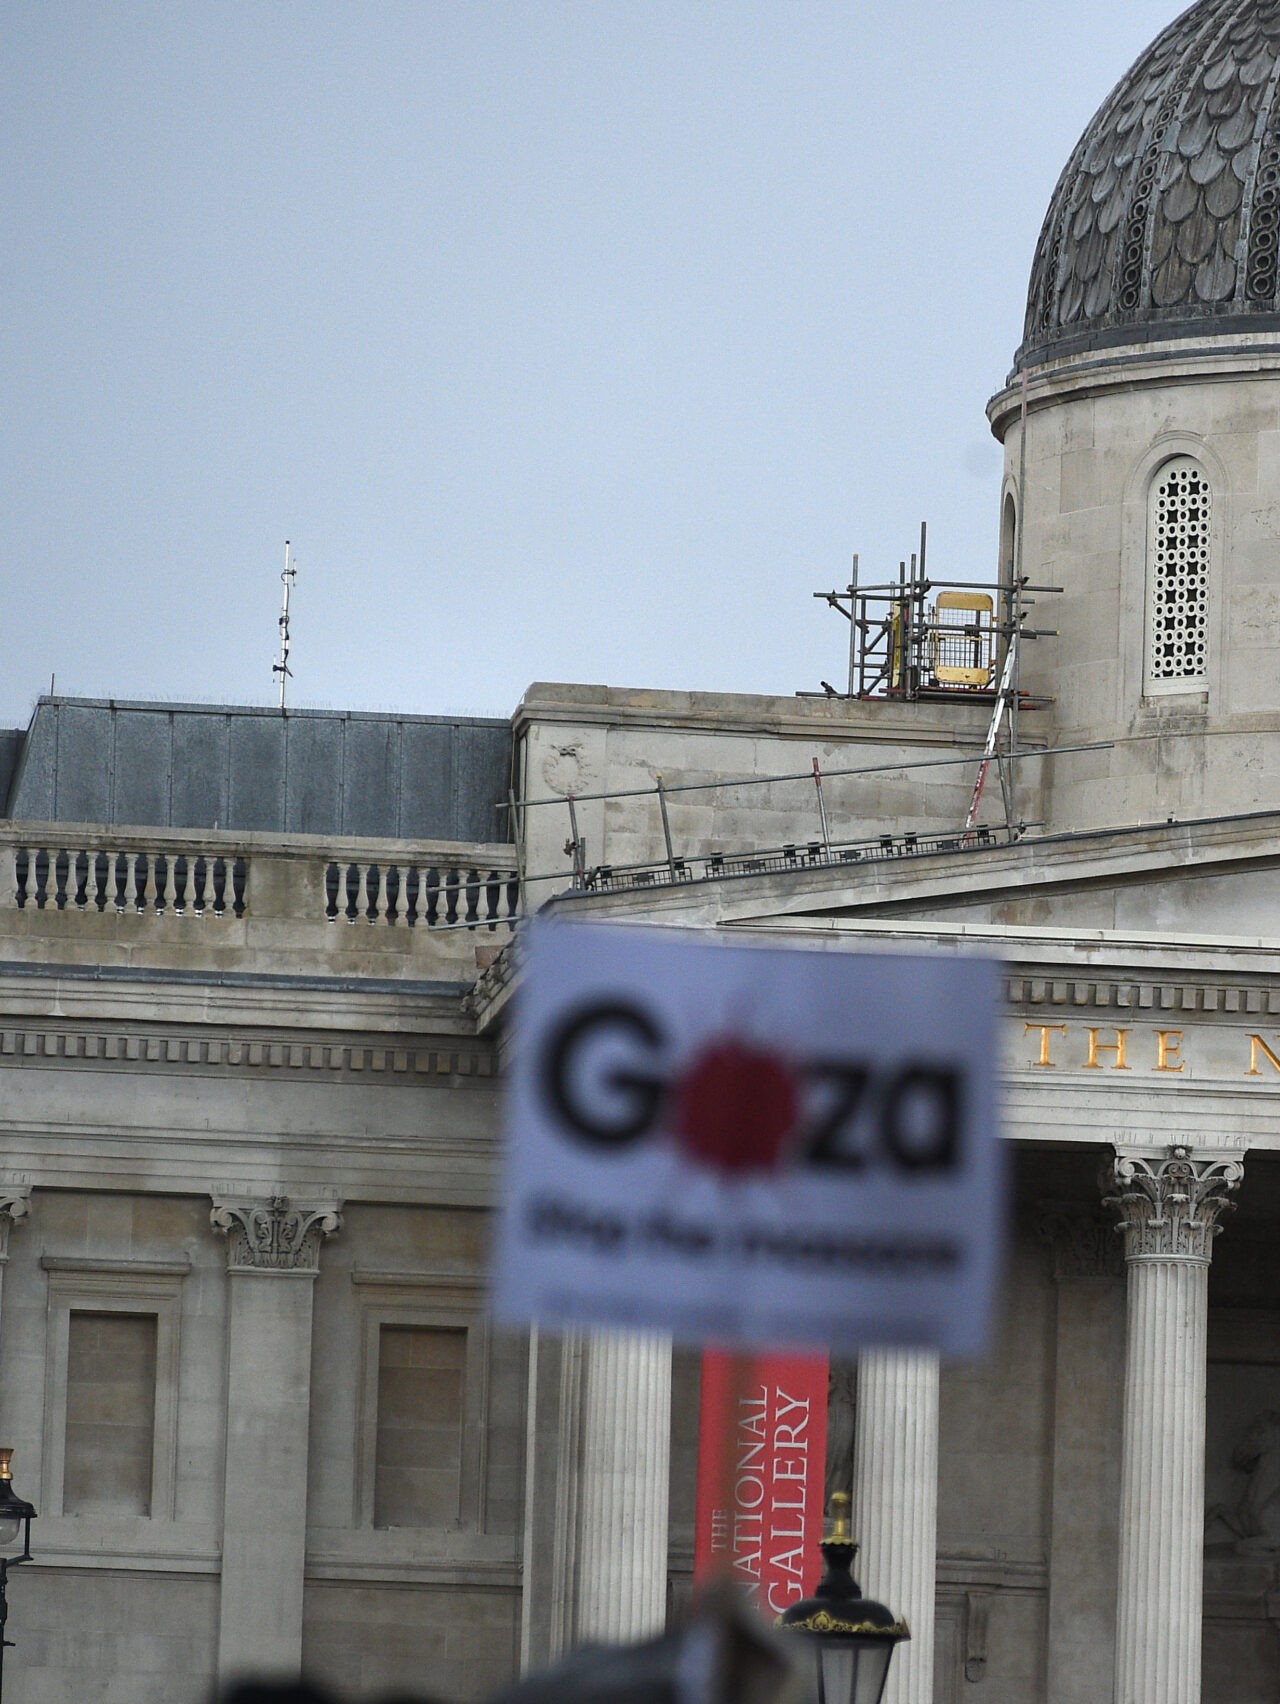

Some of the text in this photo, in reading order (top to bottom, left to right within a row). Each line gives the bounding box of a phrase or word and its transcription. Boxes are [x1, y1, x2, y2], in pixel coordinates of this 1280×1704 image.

[541, 996, 964, 1178] Gza
[1023, 1022, 1187, 1073] THE
[711, 1509, 729, 1553] THE
[767, 1385, 810, 1615] GALLERY
